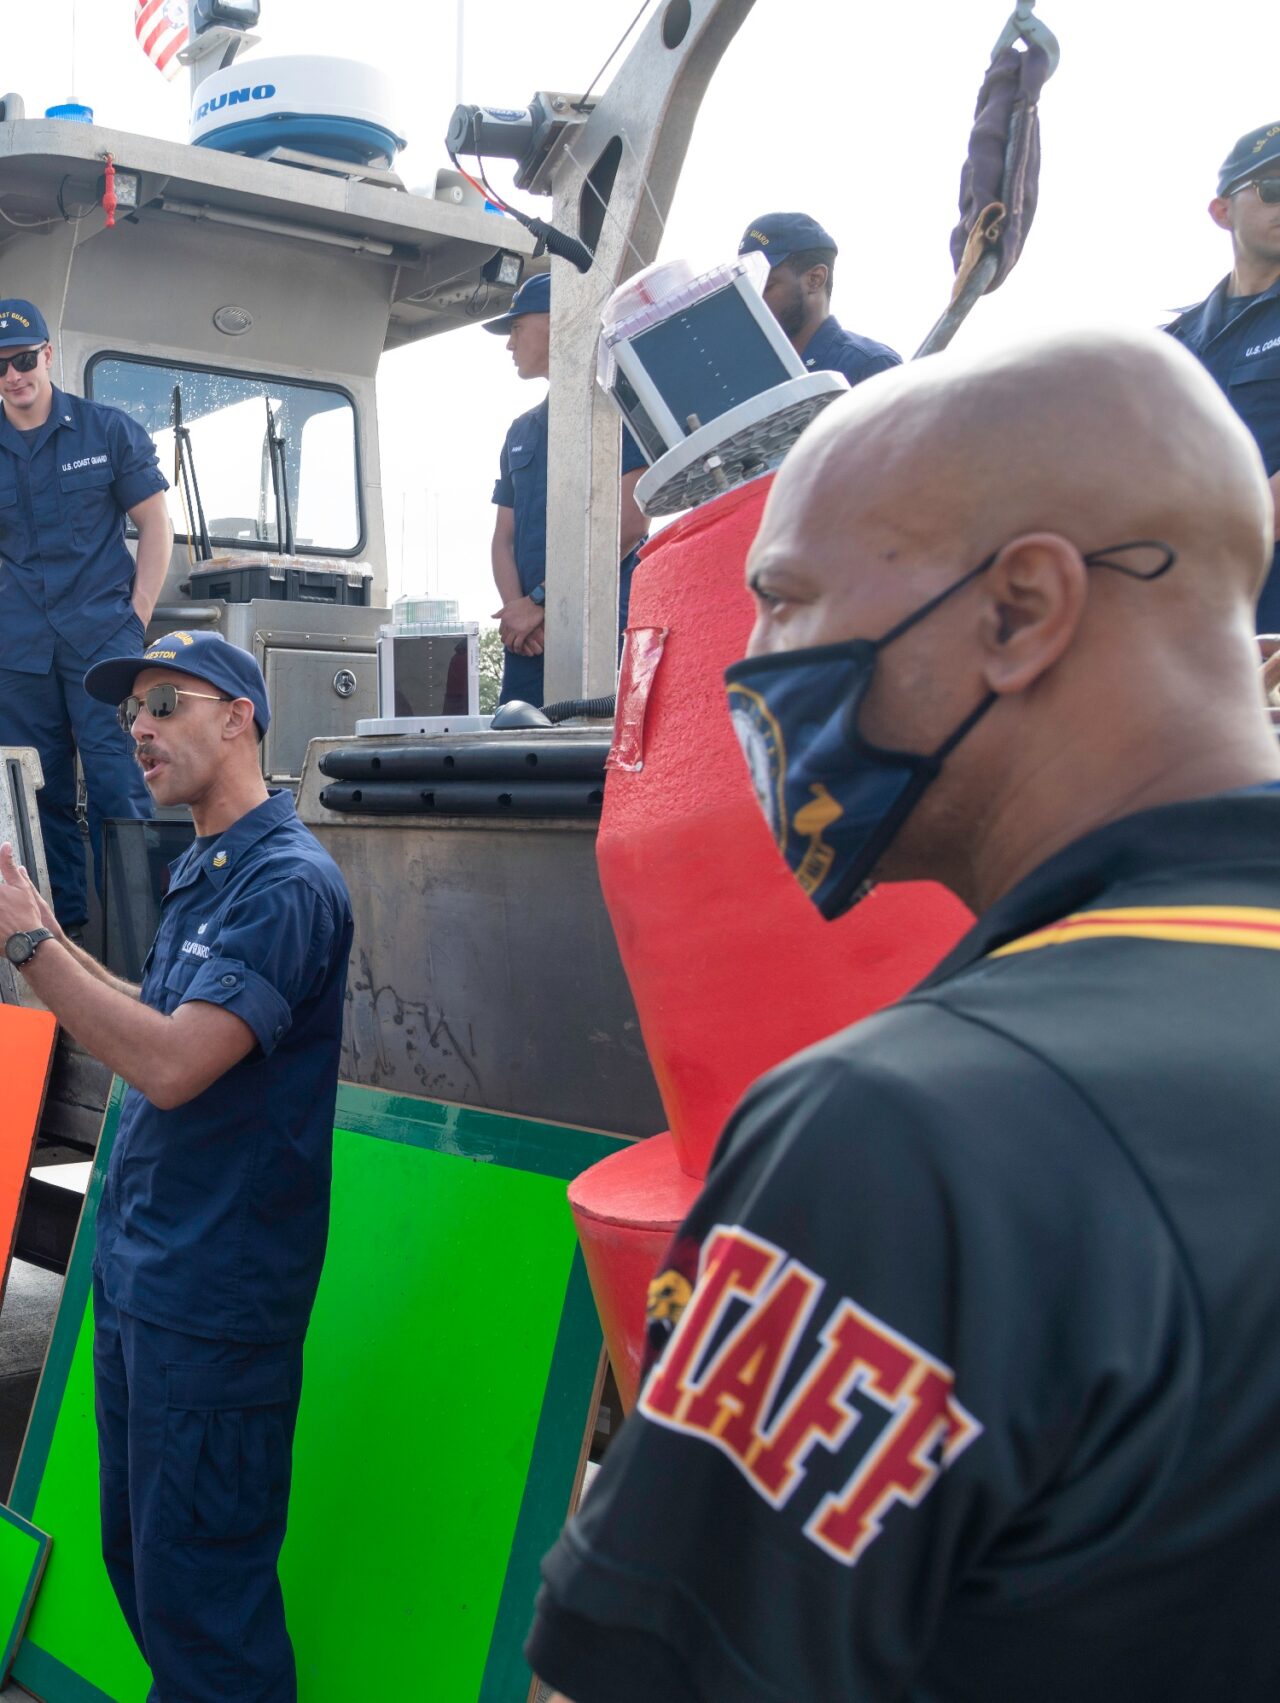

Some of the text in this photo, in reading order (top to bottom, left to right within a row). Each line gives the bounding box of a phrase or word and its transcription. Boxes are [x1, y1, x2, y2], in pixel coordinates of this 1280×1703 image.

[11, 312, 30, 328] GUARD
[61, 454, 108, 472] U.S. COAST GUARD
